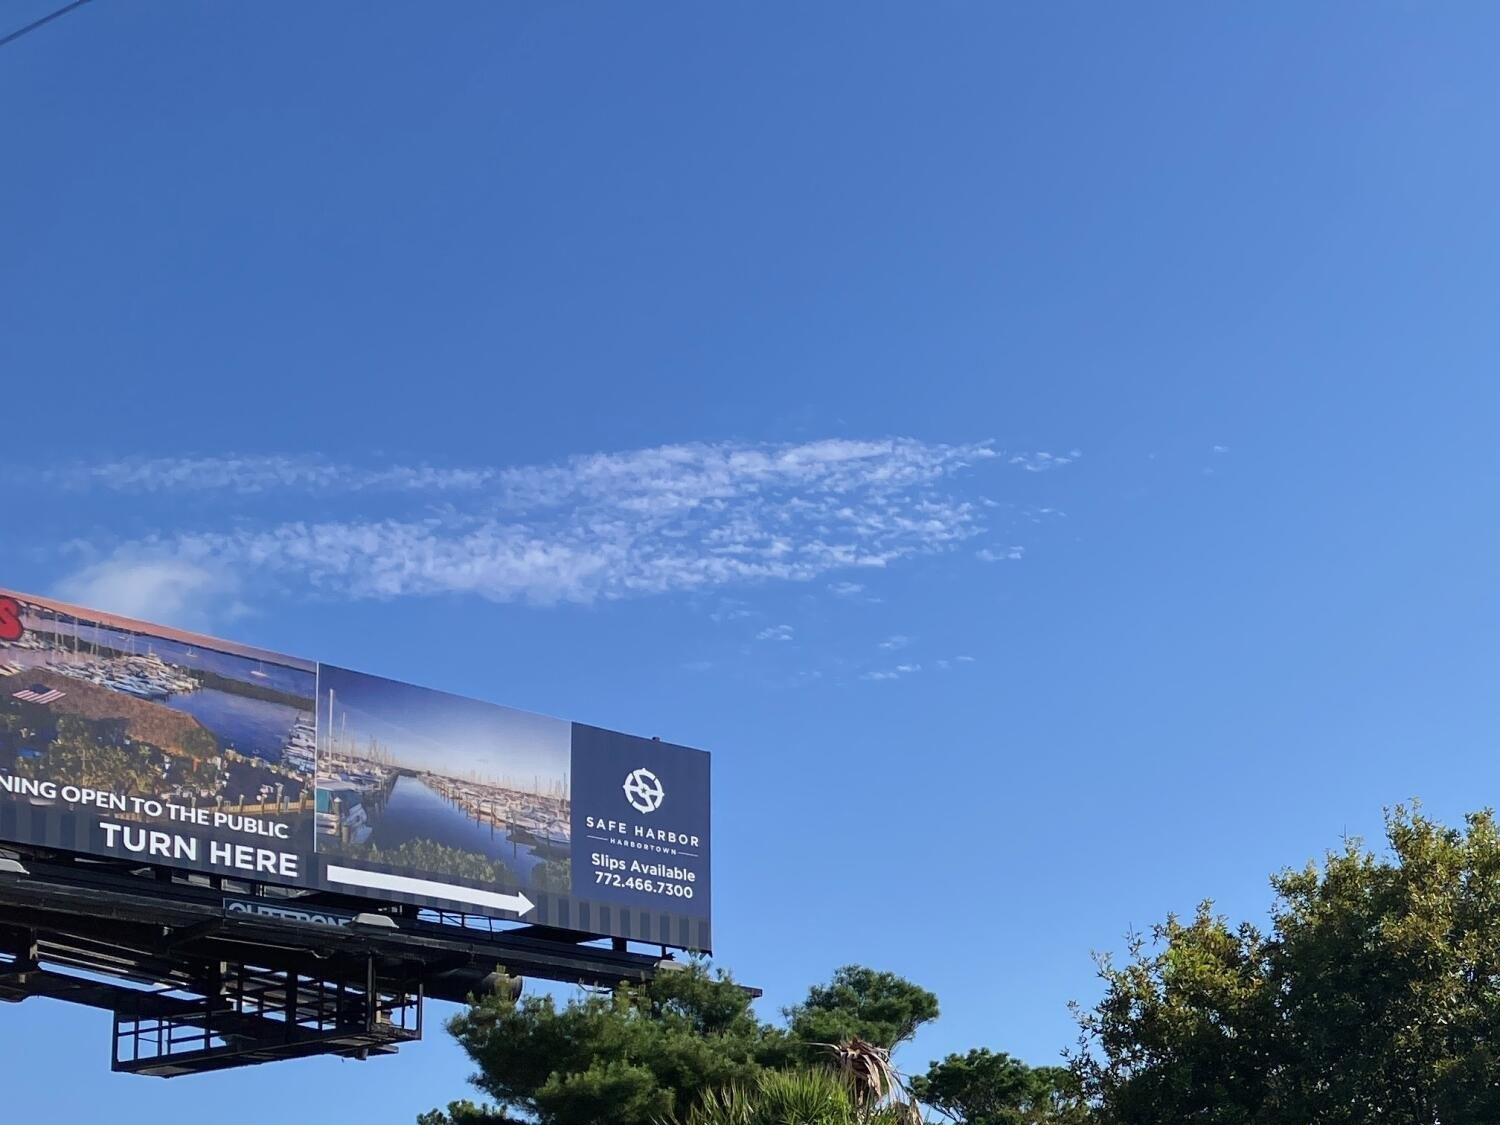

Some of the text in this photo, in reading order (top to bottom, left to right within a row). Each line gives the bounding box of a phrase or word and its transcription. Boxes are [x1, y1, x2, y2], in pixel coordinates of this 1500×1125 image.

[61, 785, 127, 810] OPEN
[130, 797, 163, 818] TO
[166, 804, 210, 826] THE
[214, 812, 289, 839] PUBLIC
[586, 816, 699, 847] SAFE HARBOR
[610, 838, 677, 855] HARBORTOWN
[99, 822, 299, 878] TURN HERE
[591, 853, 696, 882] Slips Available
[595, 871, 694, 898] 772.466.7300
